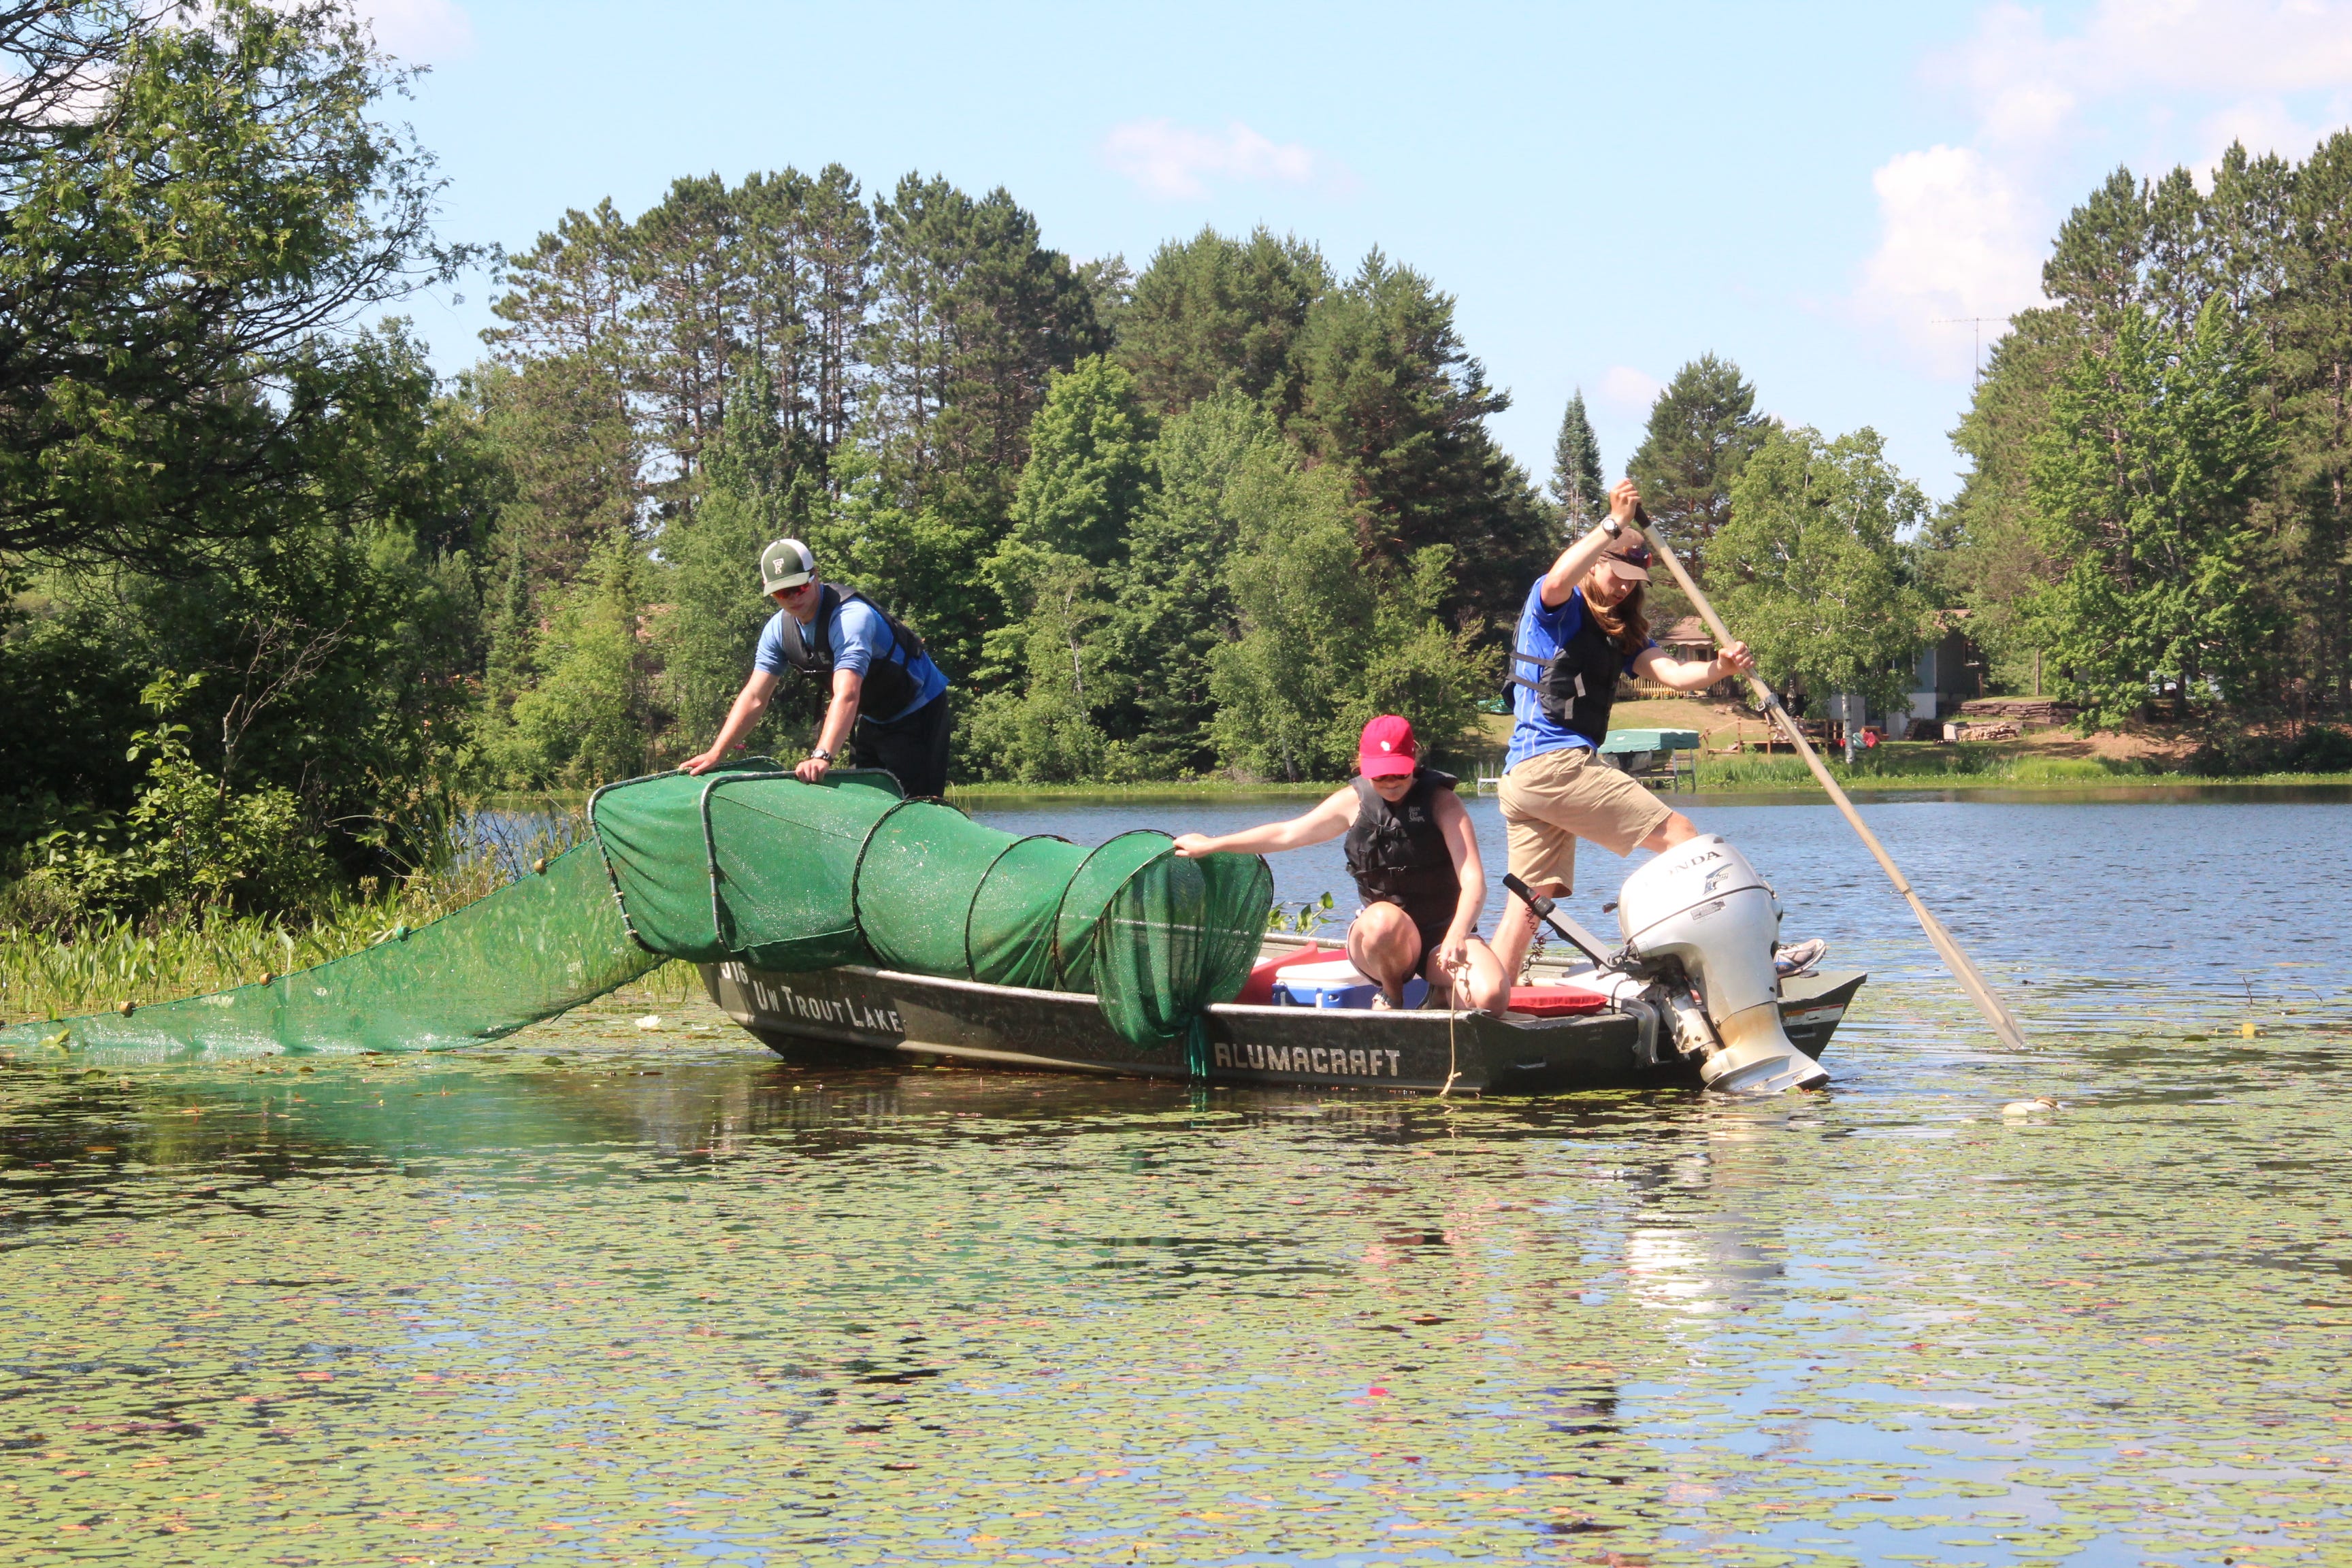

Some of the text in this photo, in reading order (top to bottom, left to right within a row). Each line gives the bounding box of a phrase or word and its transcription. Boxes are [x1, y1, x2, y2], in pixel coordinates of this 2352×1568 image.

[772, 558, 784, 574] F
[781, 985, 844, 1024] TROUT
[845, 997, 904, 1032] LAKE
[1214, 1042, 1401, 1077] ALUMACRAFT
